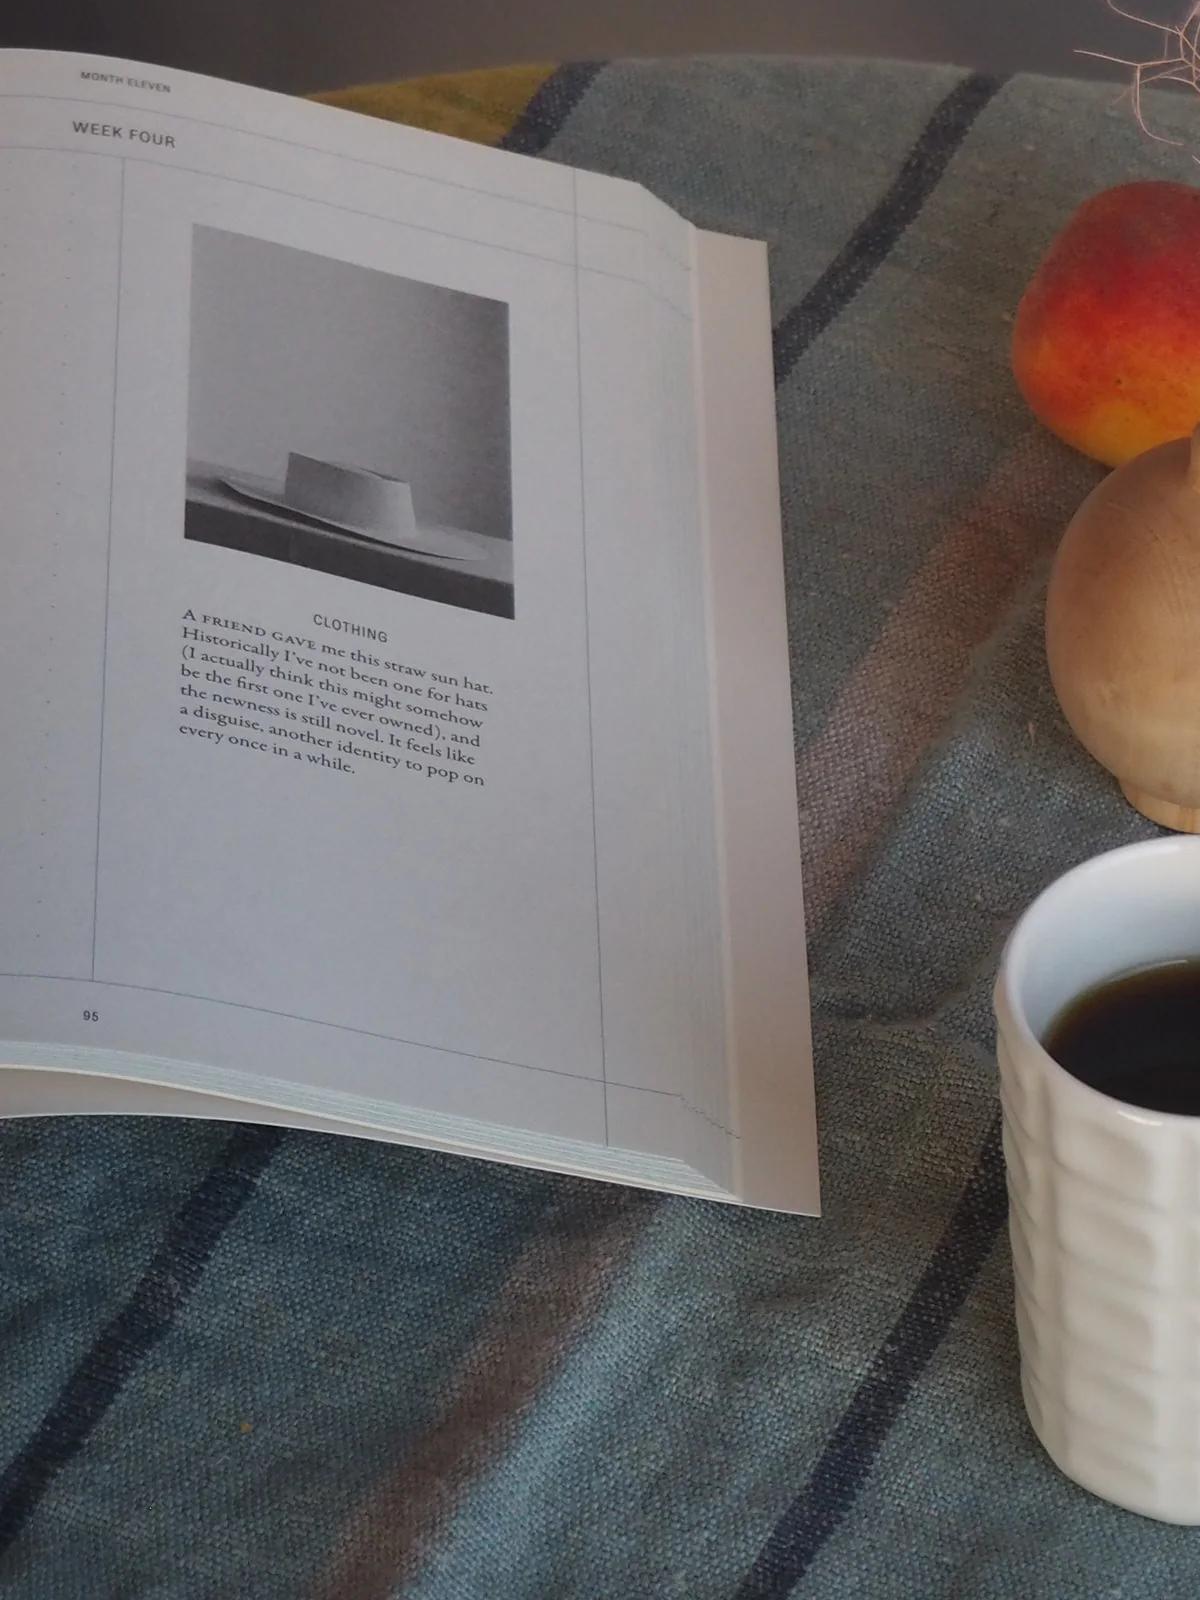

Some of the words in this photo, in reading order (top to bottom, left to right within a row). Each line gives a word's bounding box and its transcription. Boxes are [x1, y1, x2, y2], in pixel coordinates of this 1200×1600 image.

[80, 71, 124, 83] MONTH
[127, 78, 171, 93] ELEVEN
[72, 120, 122, 139] WEEK
[129, 129, 175, 148] FOUR
[181, 609, 197, 622] A
[202, 614, 266, 636] FRIEND
[271, 631, 317, 650] GAVE
[321, 644, 346, 658] me
[350, 649, 380, 667] this
[384, 661, 426, 678] straw
[431, 672, 458, 687] sun
[464, 676, 493, 695] hat.
[313, 614, 388, 643] CLOTHING
[180, 664, 201, 679] be
[205, 670, 232, 686] the
[237, 676, 268, 695] first
[273, 689, 303, 703] one
[342, 706, 376, 722] ever
[450, 734, 481, 748] and
[182, 627, 280, 662] Historically
[318, 662, 346, 677] not
[350, 667, 388, 688] been
[393, 682, 423, 696] one
[427, 687, 451, 703] for
[455, 693, 488, 712] hats
[182, 644, 196, 660] (I
[201, 652, 265, 677] actually
[270, 666, 314, 687] think
[319, 679, 349, 696] this
[353, 689, 401, 709] might
[406, 703, 484, 729] somehow
[179, 706, 188, 715] a
[269, 726, 333, 748] another
[337, 740, 401, 769] identity
[406, 760, 422, 772] to
[426, 766, 459, 783] pop
[463, 774, 485, 786] on
[179, 725, 224, 744] every
[228, 735, 268, 752] once
[273, 743, 288, 757] in
[293, 751, 303, 761] a
[307, 753, 355, 774] while.
[180, 684, 207, 700] the
[212, 693, 280, 717] newness
[285, 708, 297, 721] is
[301, 714, 331, 730] still
[336, 722, 384, 743] novel.
[389, 733, 402, 748] It
[407, 738, 442, 758] feels
[446, 747, 476, 765] like
[83, 1010, 99, 1022] 95
